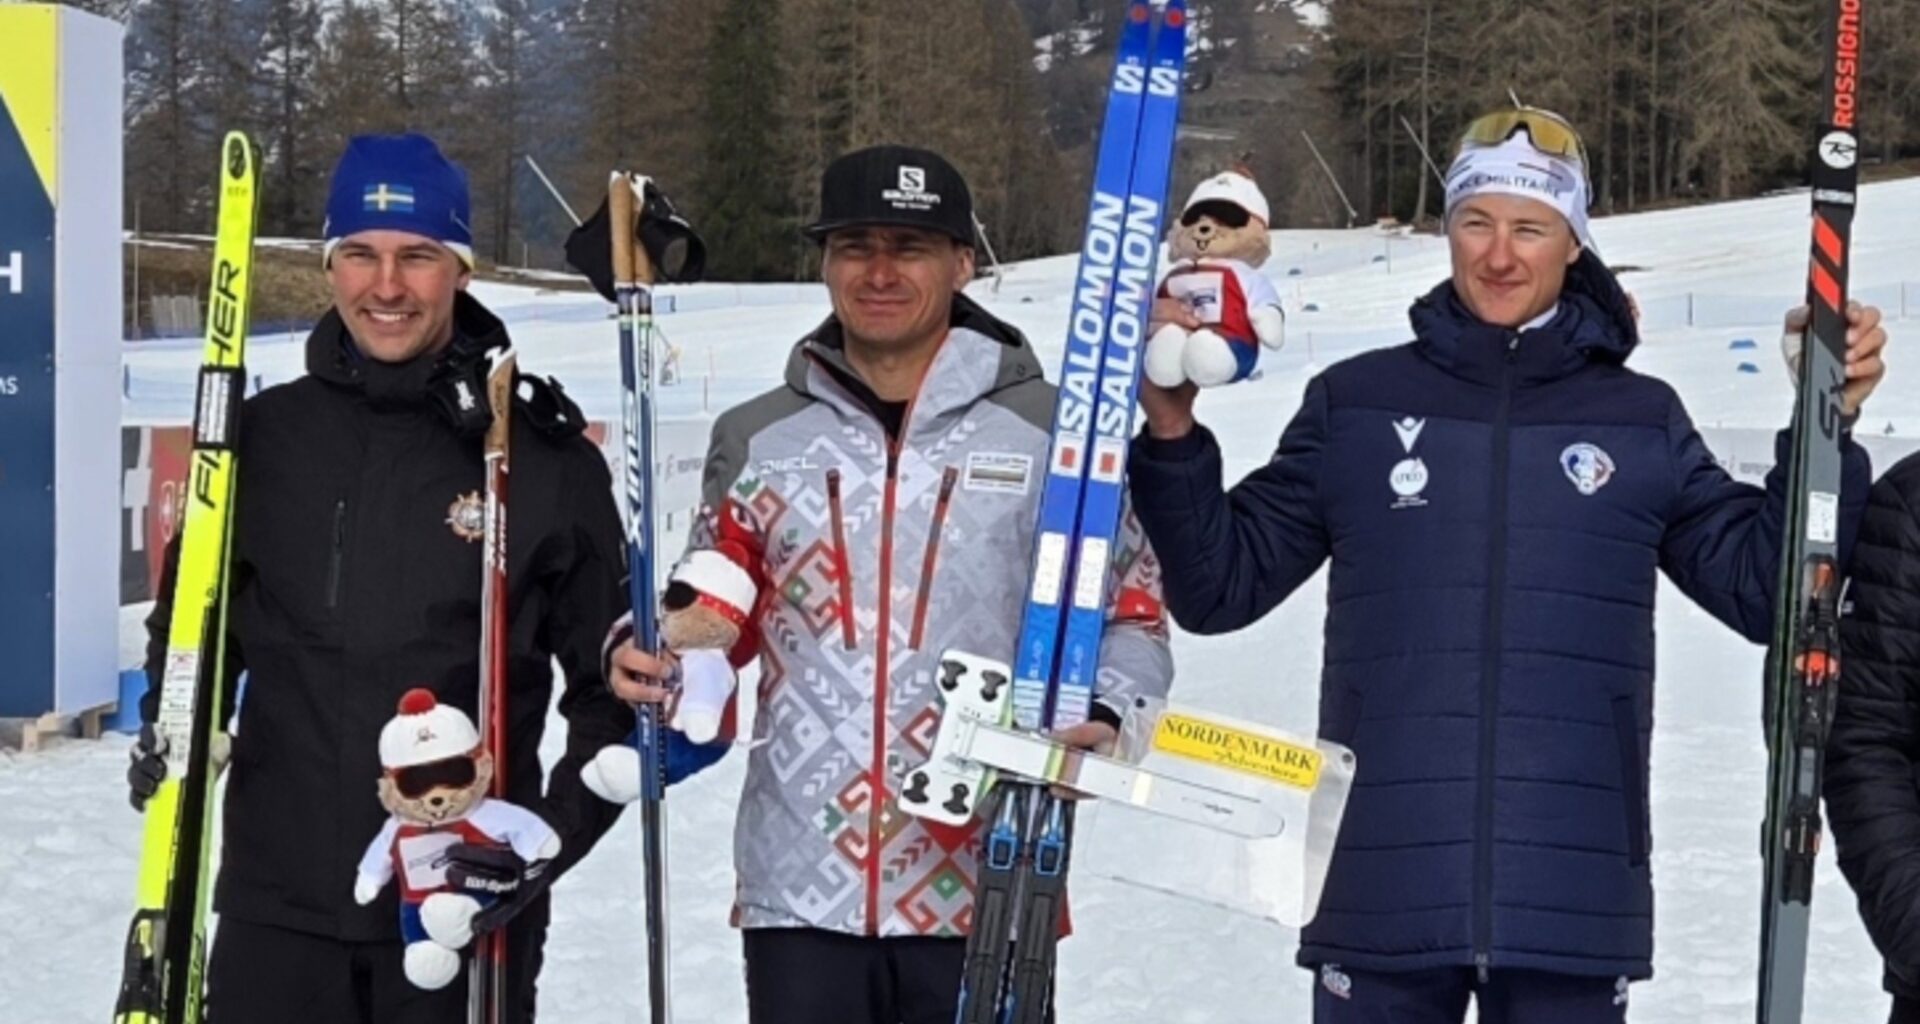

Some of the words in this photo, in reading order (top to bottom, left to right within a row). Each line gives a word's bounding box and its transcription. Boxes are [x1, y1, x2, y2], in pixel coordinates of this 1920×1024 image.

[195, 259, 241, 510] FIHER
[1058, 191, 1125, 434] SALOMON
[1096, 194, 1160, 438] SALOMON
[1162, 718, 1313, 771] NORDENMARK
